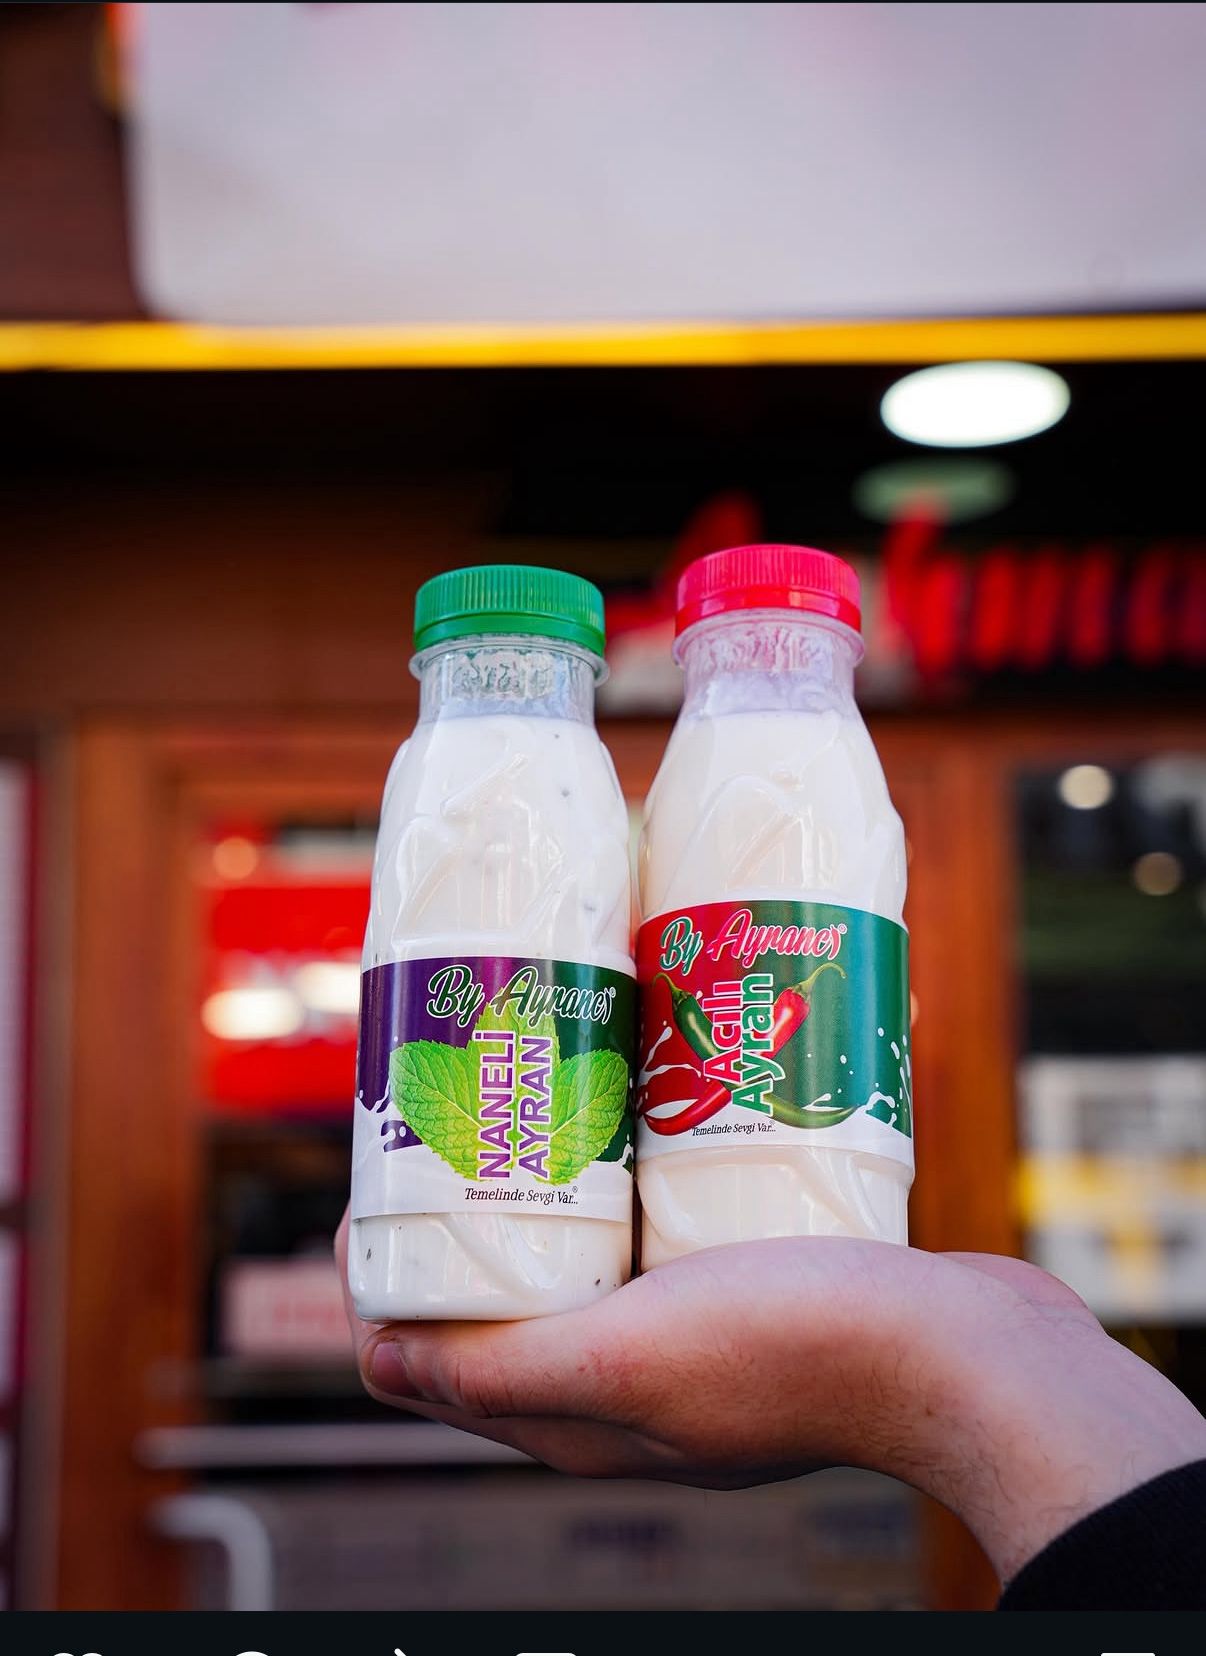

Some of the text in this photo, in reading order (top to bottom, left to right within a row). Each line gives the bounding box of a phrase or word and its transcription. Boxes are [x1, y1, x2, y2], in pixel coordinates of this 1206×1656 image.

[660, 915, 703, 975] By
[426, 964, 485, 1028] By
[731, 973, 786, 1117] Ayran
[515, 1036, 555, 1180] AYRAN
[692, 1123, 733, 1137] Temelinde
[733, 1122, 756, 1135] Sevgi
[464, 1187, 525, 1202] Temelinde
[526, 1189, 556, 1206] Sevgi
